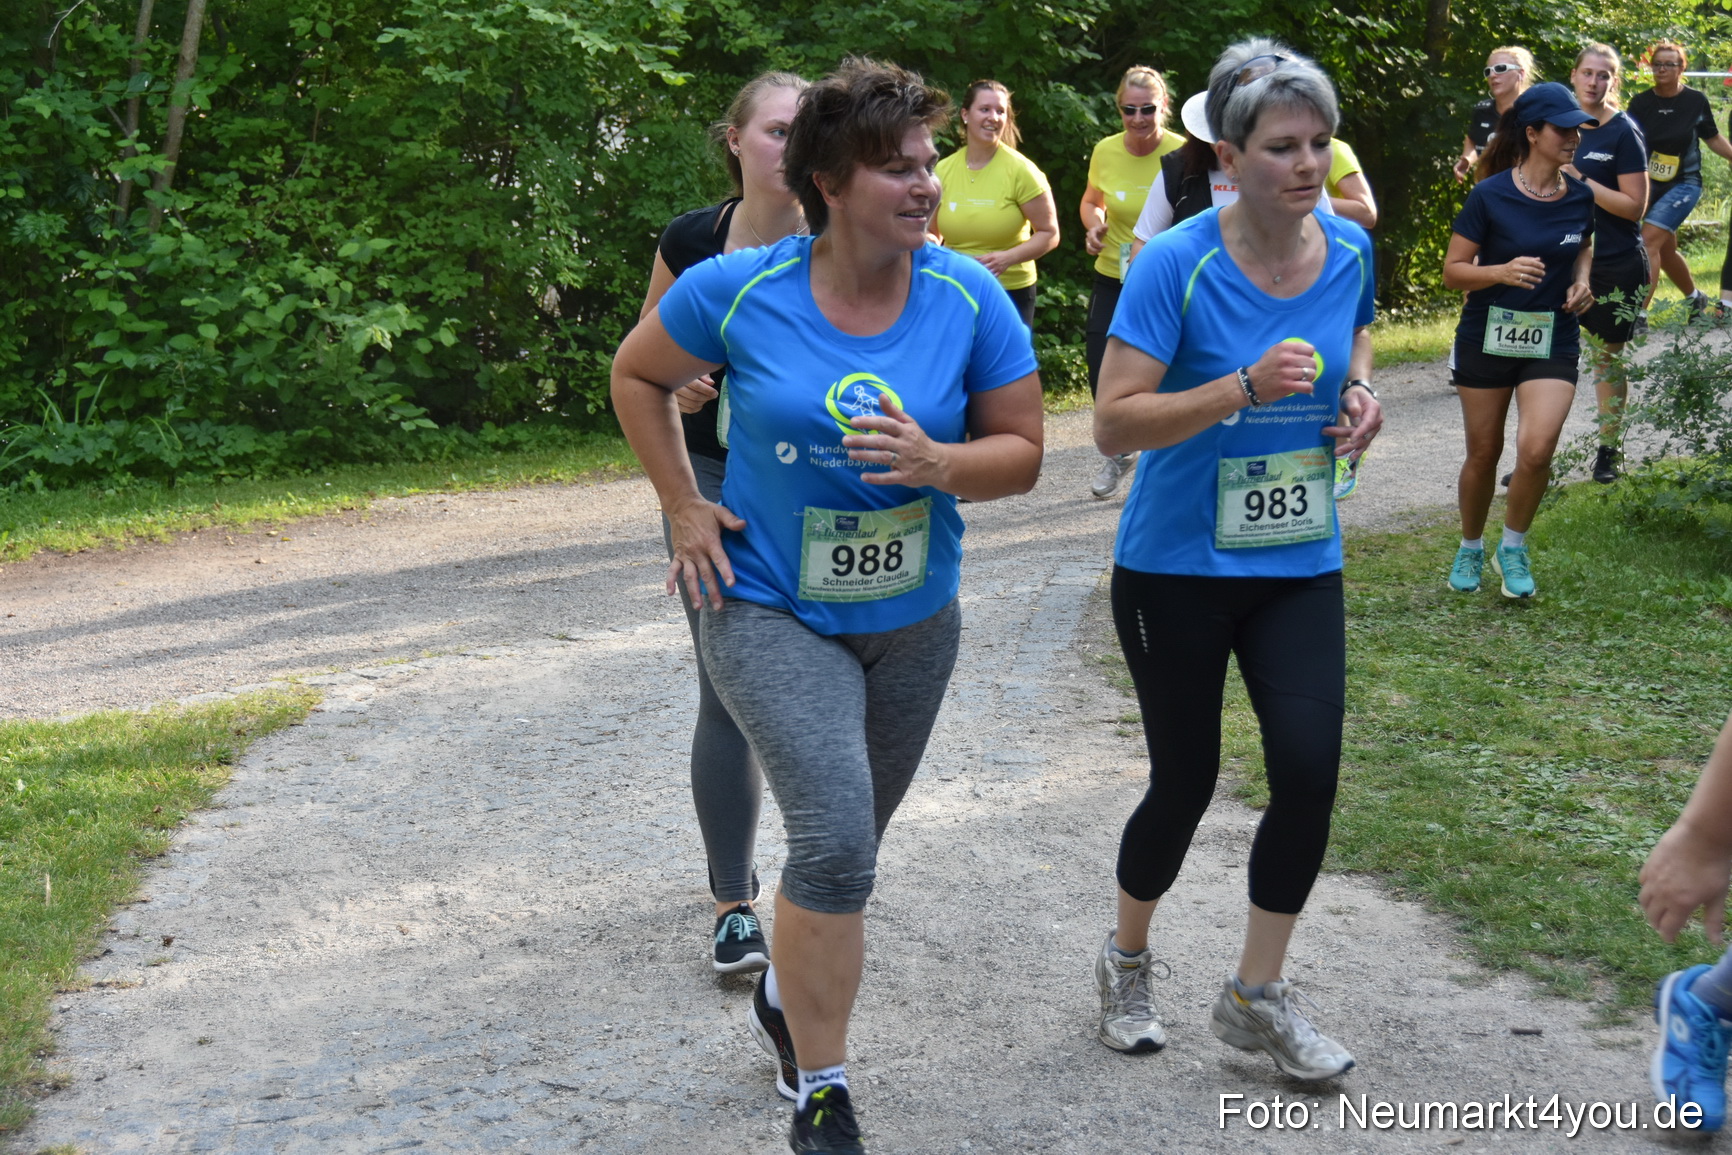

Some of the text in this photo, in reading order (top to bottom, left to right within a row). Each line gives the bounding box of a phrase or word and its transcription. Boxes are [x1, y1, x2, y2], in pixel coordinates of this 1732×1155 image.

[1650, 161, 1672, 174] 1981
[1494, 325, 1543, 345] 1440
[1244, 484, 1308, 522] 983
[1239, 517, 1313, 532] Eichenseer Doris
[831, 540, 904, 577] 988
[822, 570, 909, 586] Schneider Claudia
